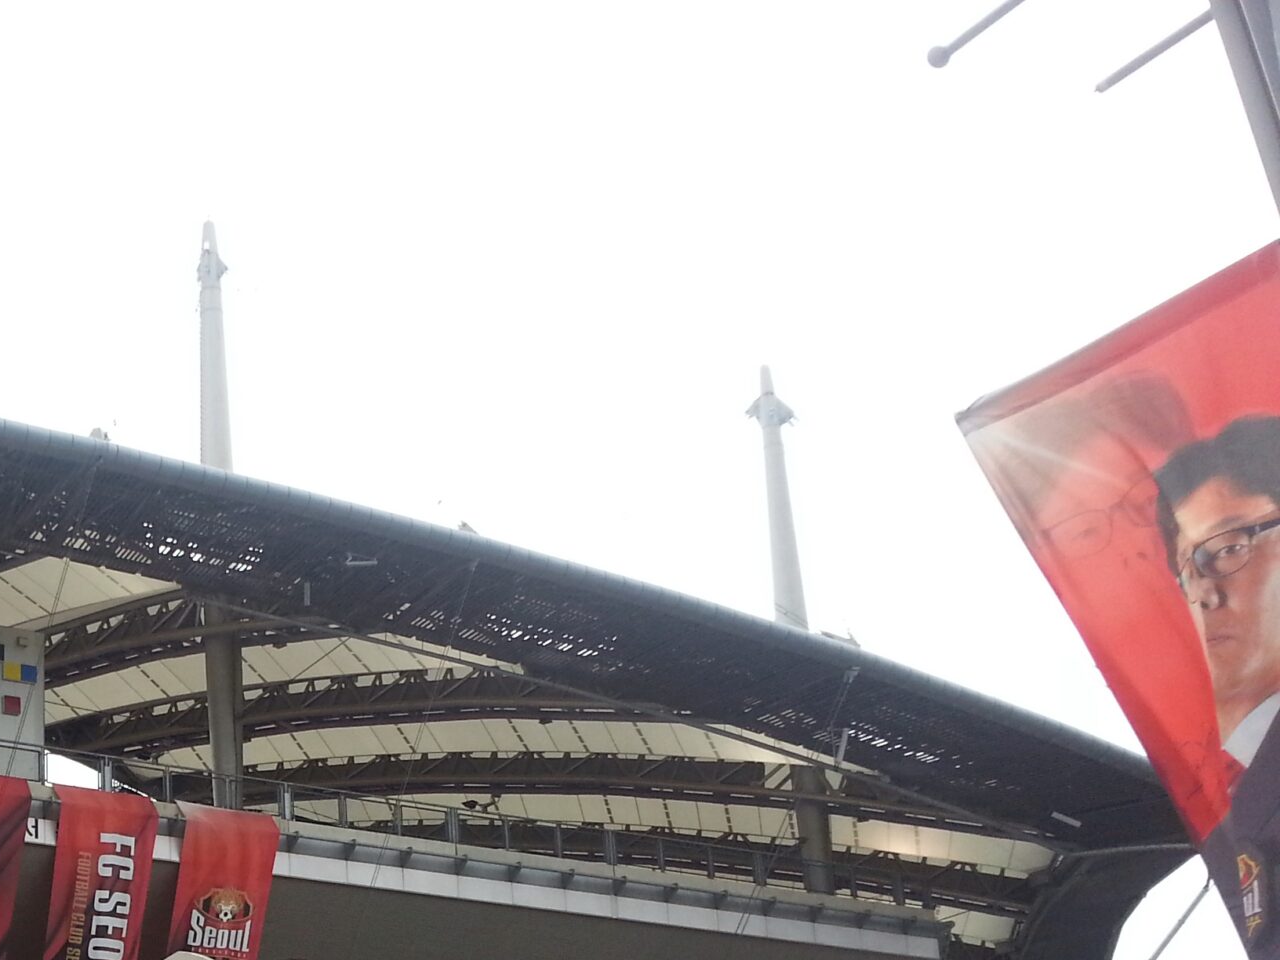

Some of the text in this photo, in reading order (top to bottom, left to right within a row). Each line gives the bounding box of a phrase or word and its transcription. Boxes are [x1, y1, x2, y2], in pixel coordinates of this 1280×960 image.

[98, 833, 136, 880] FC
[73, 851, 91, 910] FOOTBALL
[68, 912, 84, 944] CLUB
[187, 909, 253, 952] Seoul
